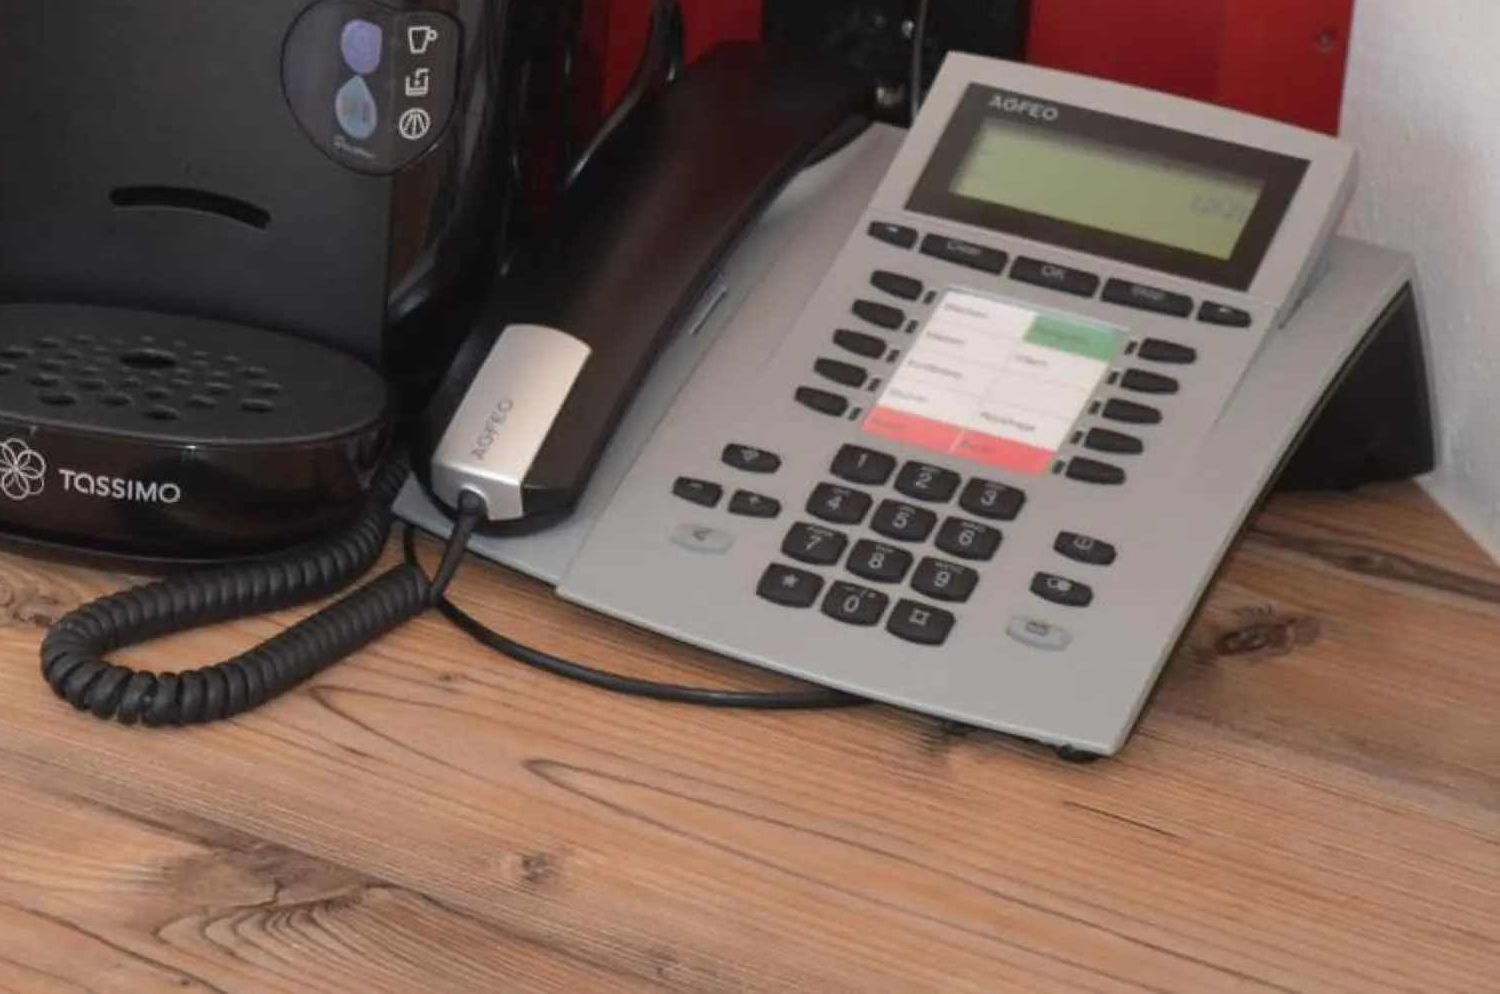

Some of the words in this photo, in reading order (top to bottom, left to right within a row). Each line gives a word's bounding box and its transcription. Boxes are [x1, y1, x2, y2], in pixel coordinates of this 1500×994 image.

[987, 94, 1060, 122] AGFEO
[471, 397, 514, 460] AGFEO
[857, 453, 867, 469] 1
[915, 472, 933, 489] 2
[826, 495, 843, 511] 4
[980, 488, 998, 507] 3
[891, 510, 910, 530] 5
[805, 534, 822, 551] 7
[957, 527, 976, 547] 6
[867, 550, 886, 570] 8
[932, 568, 950, 589] 9
[843, 595, 861, 614] 0
